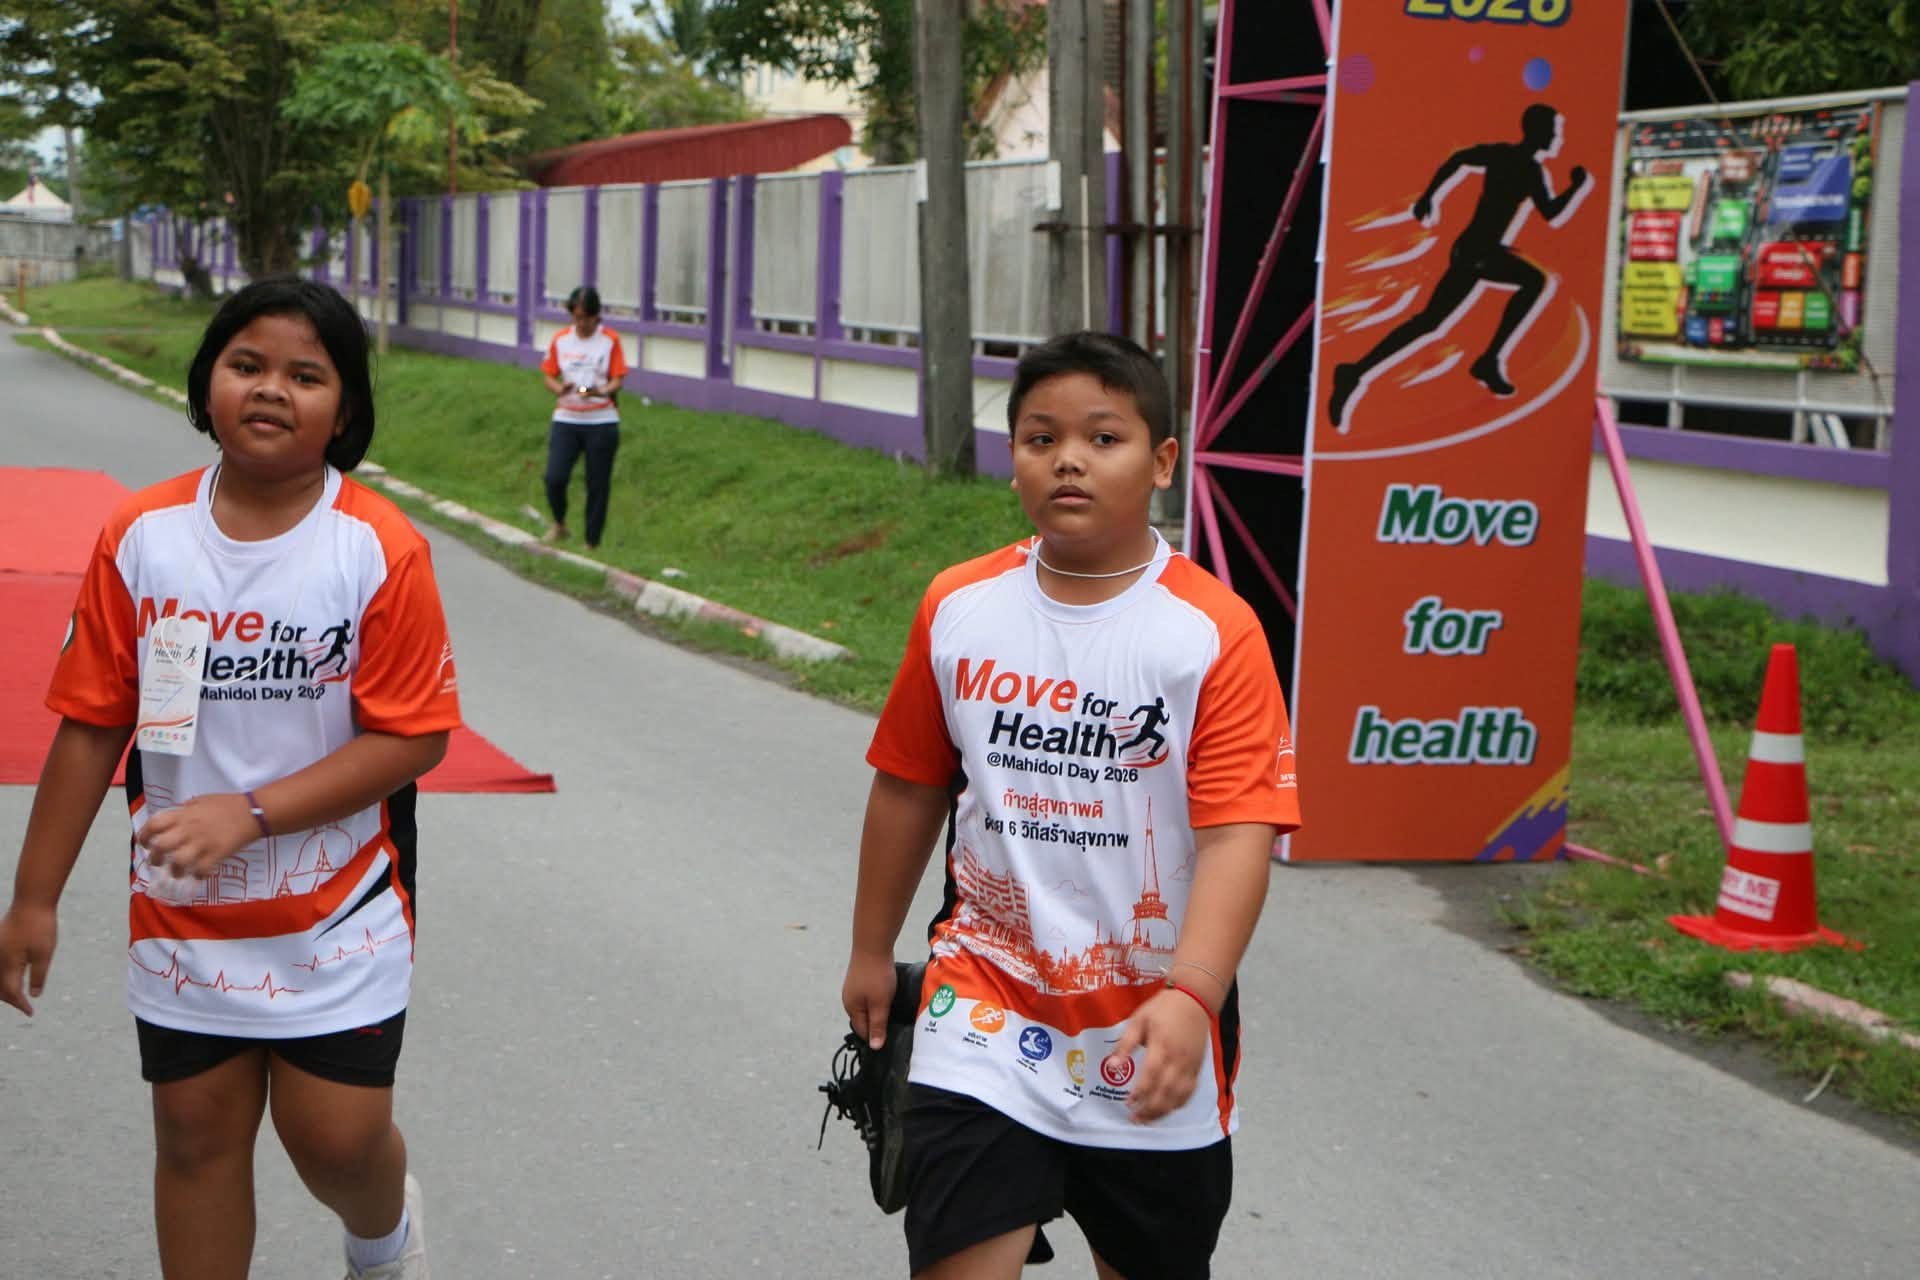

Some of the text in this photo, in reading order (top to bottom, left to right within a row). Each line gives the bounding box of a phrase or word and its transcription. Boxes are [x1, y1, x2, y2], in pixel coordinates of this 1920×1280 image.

[1378, 486, 1538, 545] Move
[270, 620, 307, 642] for
[1404, 597, 1502, 655] for
[199, 687, 257, 701] Mahidol
[261, 687, 293, 701] Day
[955, 658, 1119, 718] Move for
[988, 710, 1118, 760] Health
[1350, 706, 1537, 765] health
[986, 752, 1139, 784] @Mahidol Day 2026
[1003, 788, 1104, 820] ก้าวสู่สุขภาพดี
[1008, 820, 1017, 836] 6
[1021, 820, 1129, 852] วิถีสร้างสุขภาพ
